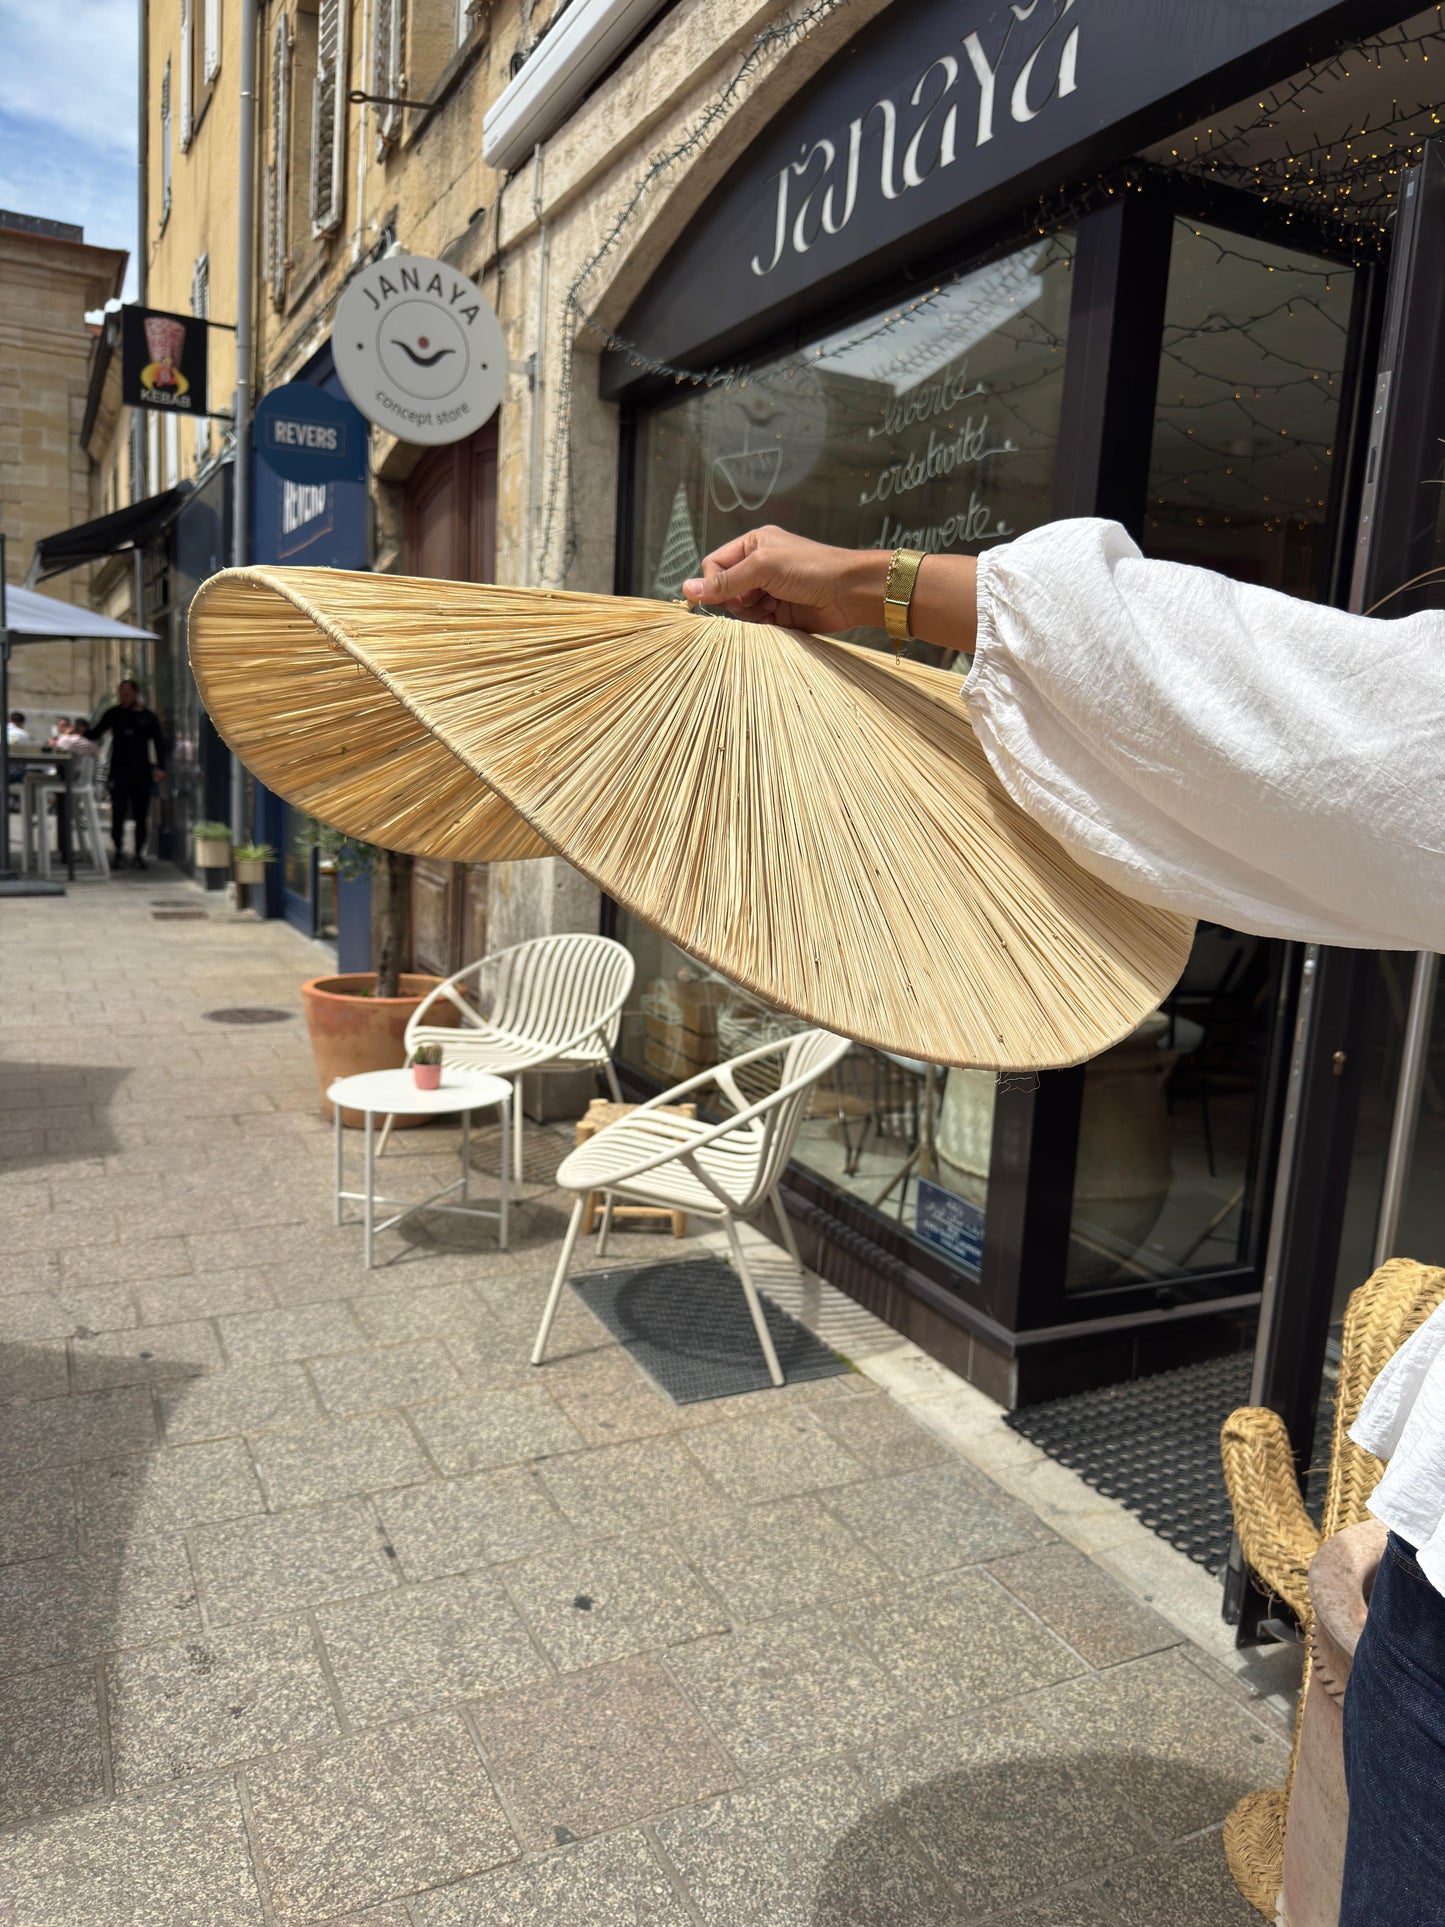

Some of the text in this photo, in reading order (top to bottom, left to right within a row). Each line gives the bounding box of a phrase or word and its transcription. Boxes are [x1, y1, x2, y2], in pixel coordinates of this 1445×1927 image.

[362, 267, 480, 326] JANAYA
[140, 387, 192, 409] KEBAB
[375, 390, 471, 428] concept store
[273, 419, 338, 451] REVERS
